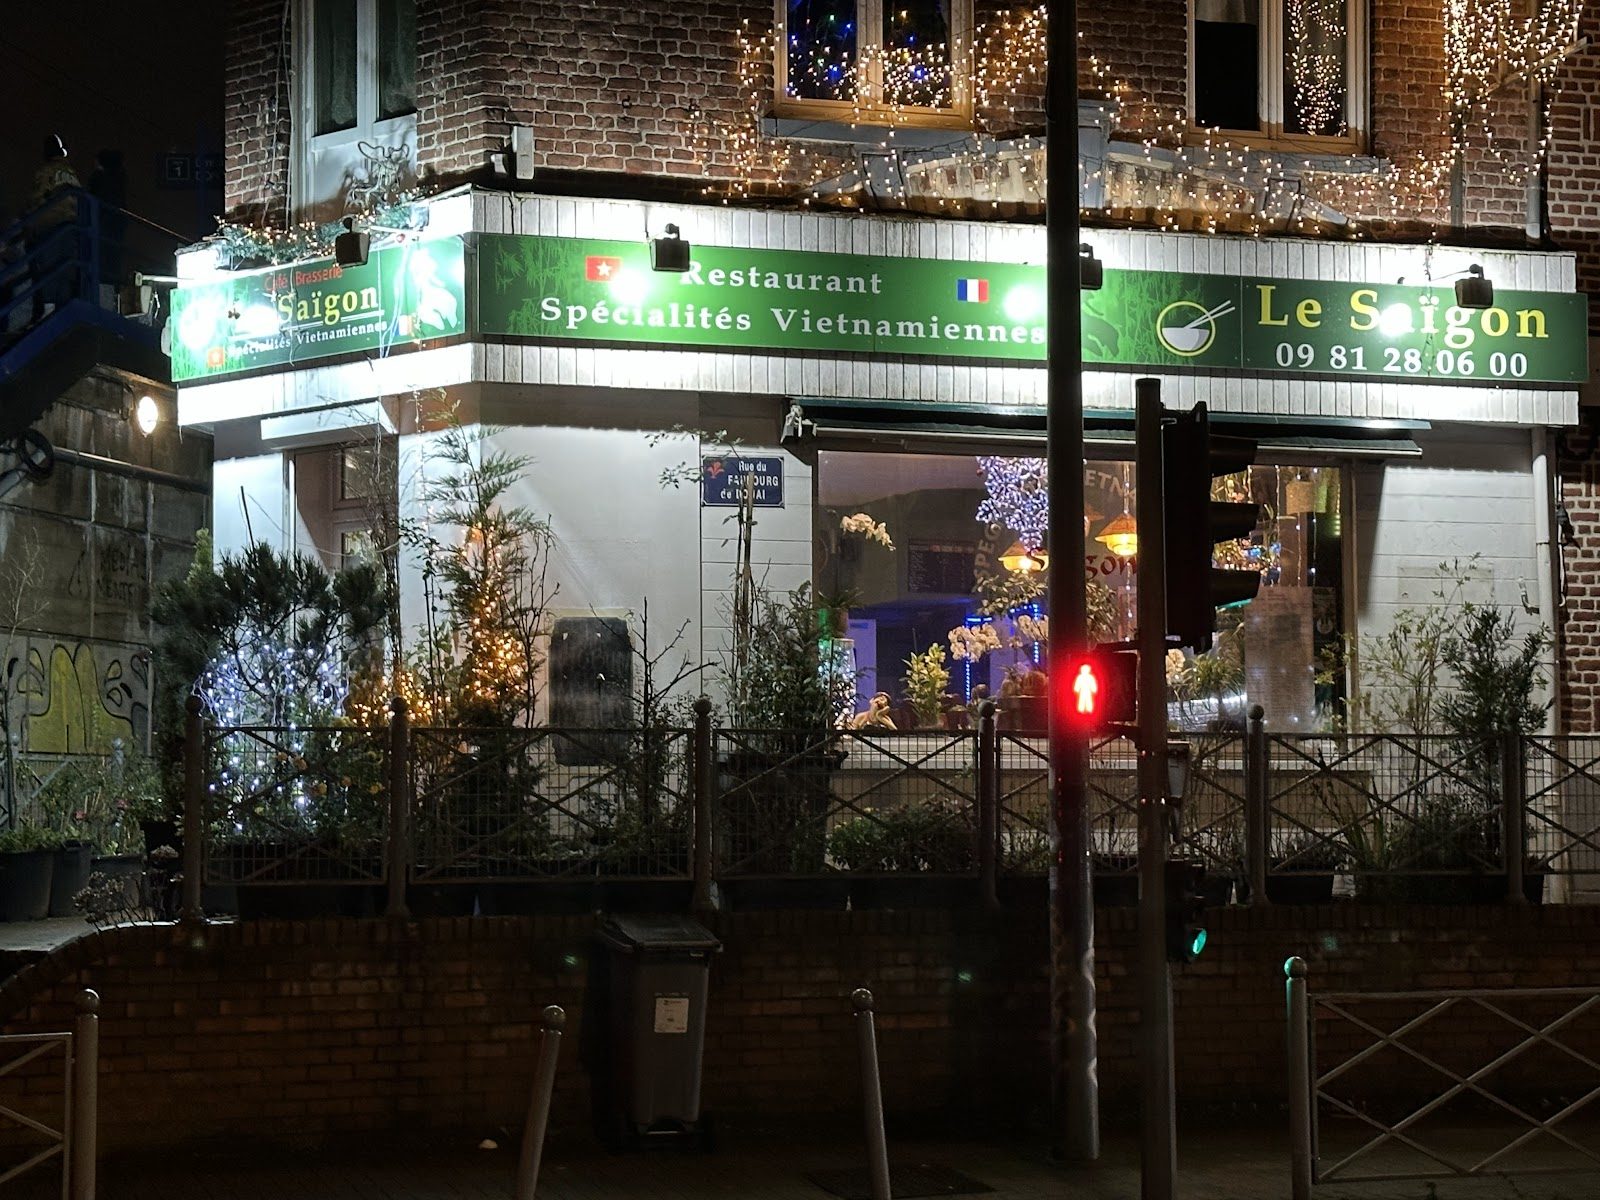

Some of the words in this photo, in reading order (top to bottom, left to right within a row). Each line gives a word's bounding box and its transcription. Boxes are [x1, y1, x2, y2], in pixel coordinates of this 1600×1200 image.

[295, 267, 343, 286] Brasserie
[680, 261, 882, 295] Restaurant
[277, 286, 379, 326] Saïgon
[541, 297, 752, 331] Spécialités
[771, 308, 1046, 345] Vietnamiennes
[1256, 285, 1322, 328] Le
[1350, 289, 1549, 349] Saïgon
[296, 321, 388, 345] Vietnamiennes
[1275, 342, 1315, 368] 09
[1329, 345, 1368, 371] 81
[1383, 347, 1422, 373] 28
[1436, 350, 1475, 376] 06
[1489, 352, 1528, 378] 00
[727, 474, 779, 487] FAUOURG
[738, 461, 755, 472] Rue
[756, 461, 767, 472] du
[720, 488, 732, 499] de
[1026, 547, 1137, 580] Sgon
